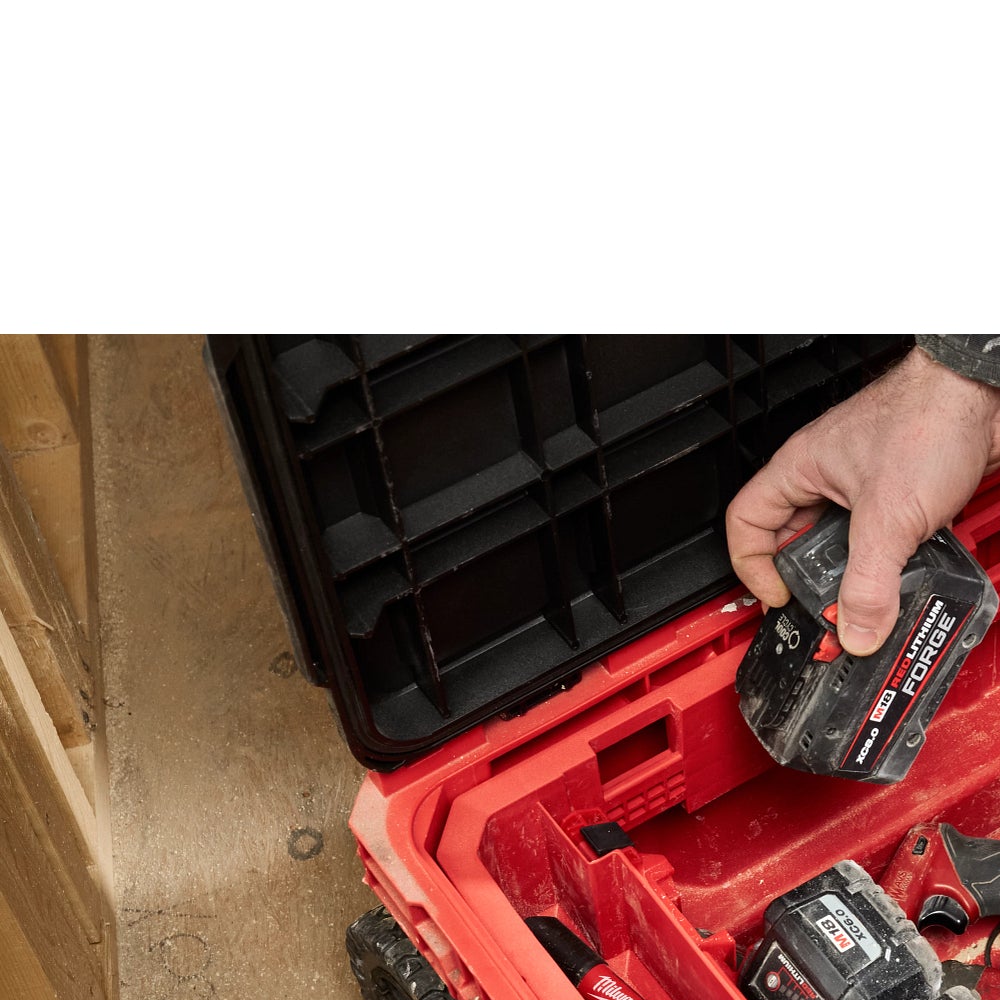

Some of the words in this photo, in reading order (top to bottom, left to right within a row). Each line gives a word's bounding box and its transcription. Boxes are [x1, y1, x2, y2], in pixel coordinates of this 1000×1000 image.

[775, 620, 789, 641] COOL
[873, 692, 893, 721] M18
[890, 600, 943, 688] REDLITHIUM
[902, 612, 956, 696] FORGE
[820, 919, 852, 951] M18
[835, 908, 867, 942] XC6.0
[778, 953, 817, 1000] REDLITHIUM
